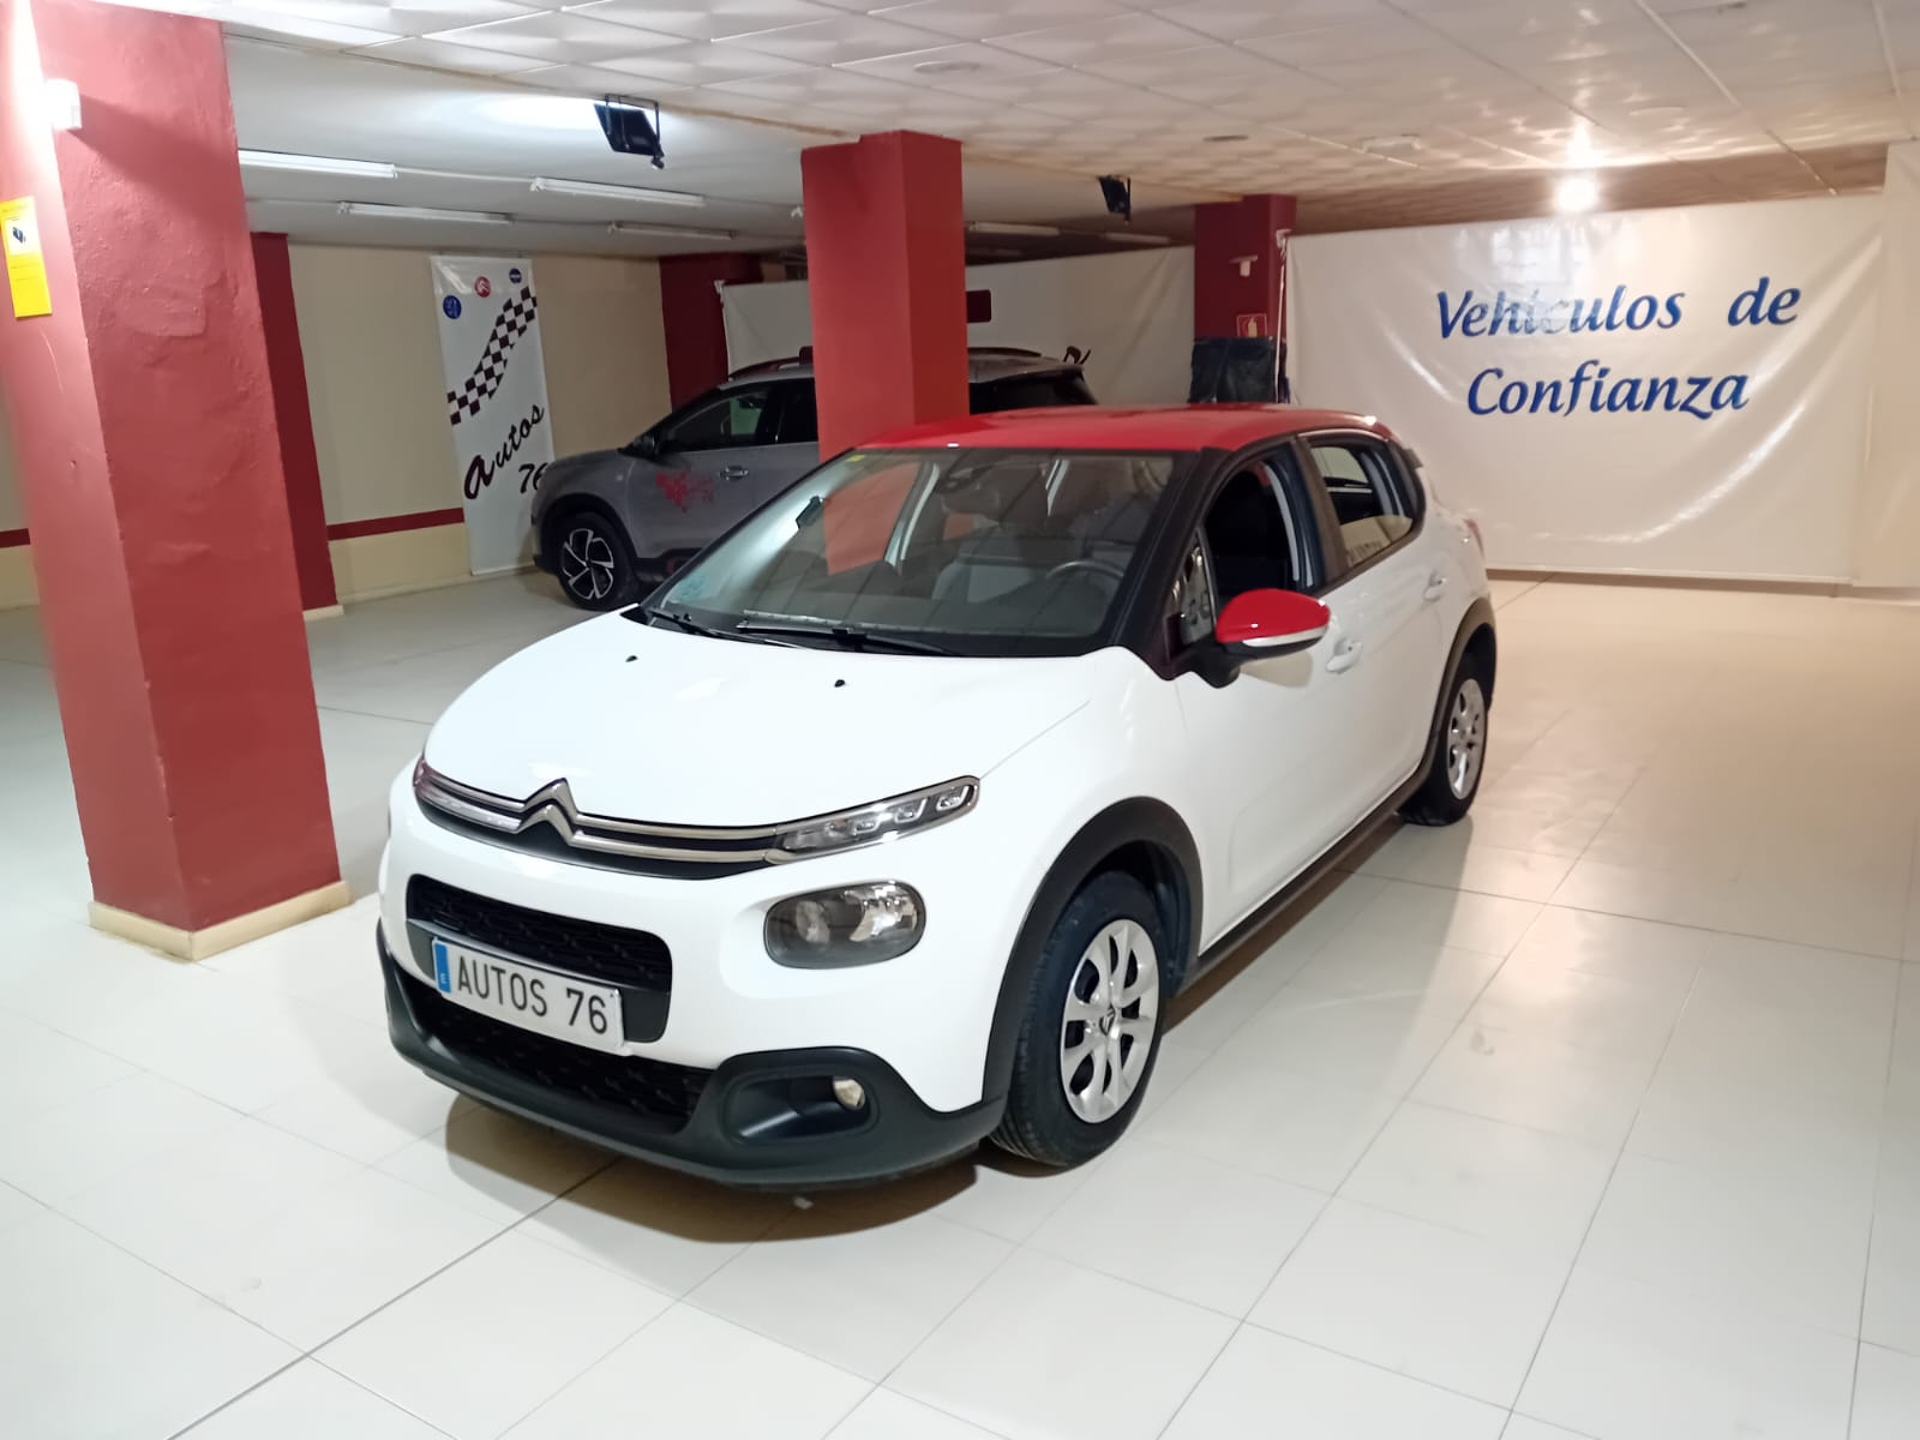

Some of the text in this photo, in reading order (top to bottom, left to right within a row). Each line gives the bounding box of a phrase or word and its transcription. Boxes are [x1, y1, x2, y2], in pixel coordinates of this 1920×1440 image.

[1727, 276, 1801, 327] de
[1467, 359, 1750, 420] Confianza
[458, 955, 608, 1035] AUTOS 76
